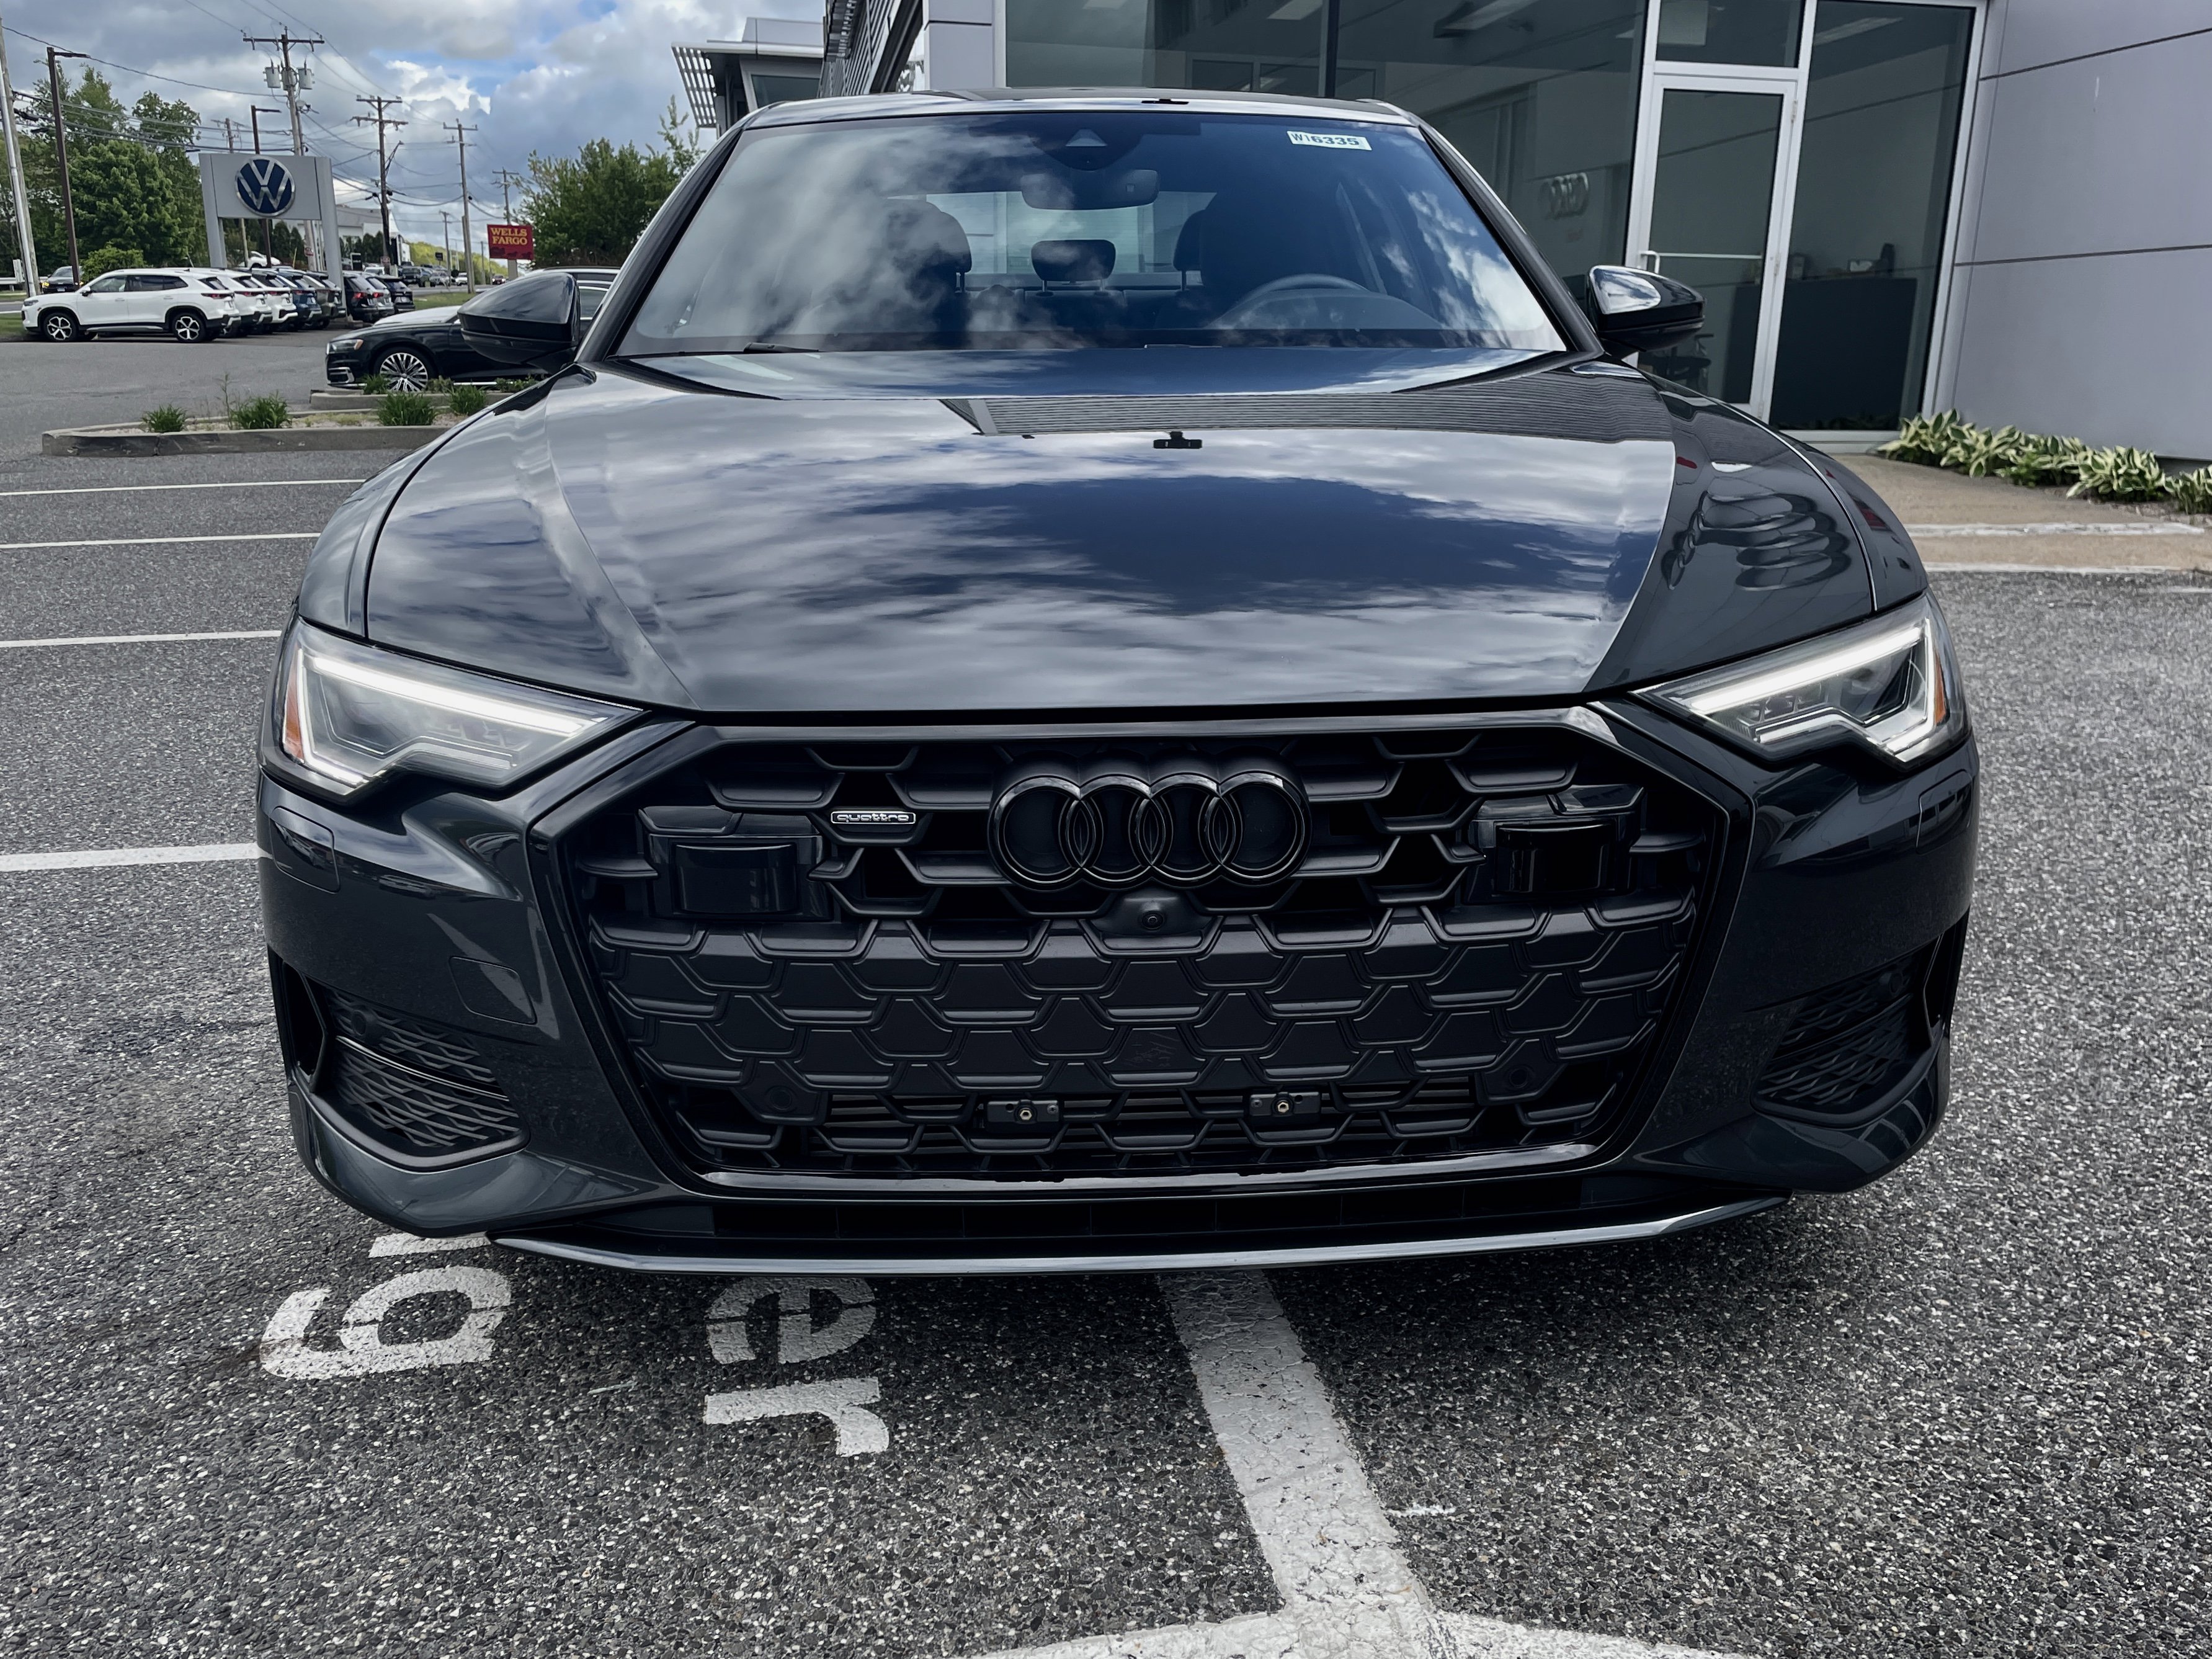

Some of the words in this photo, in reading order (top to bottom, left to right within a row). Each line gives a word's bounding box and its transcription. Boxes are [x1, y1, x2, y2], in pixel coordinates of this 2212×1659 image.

[490, 227, 528, 237] WELLS
[492, 236, 528, 246] FARGO
[837, 813, 909, 823] quattro
